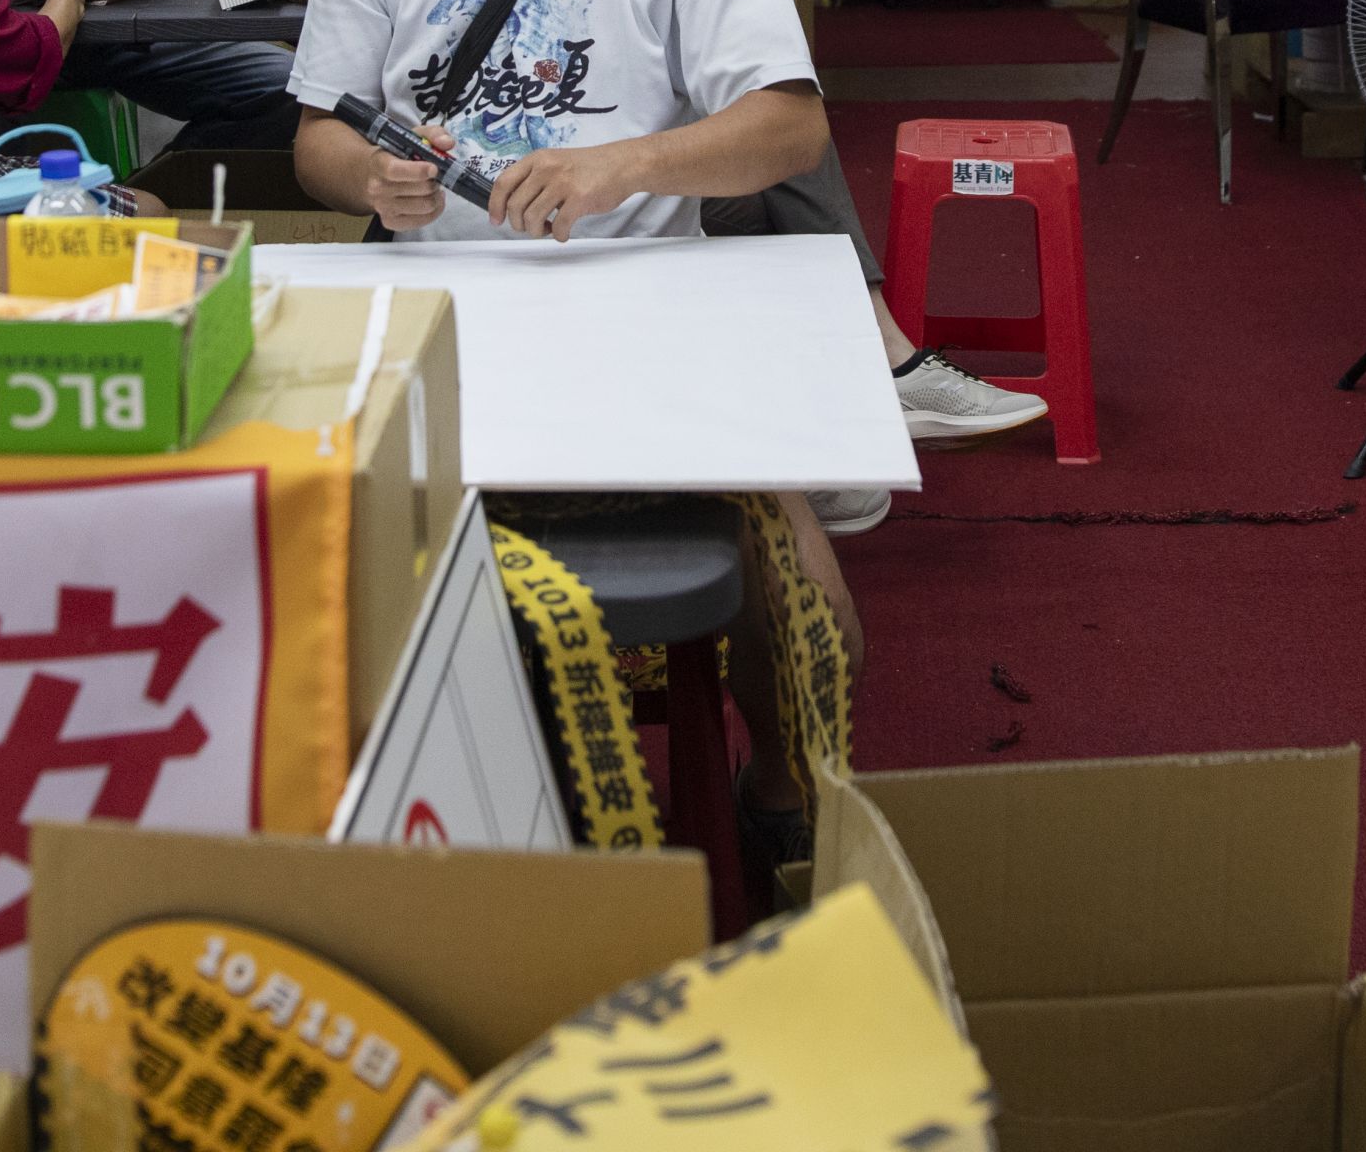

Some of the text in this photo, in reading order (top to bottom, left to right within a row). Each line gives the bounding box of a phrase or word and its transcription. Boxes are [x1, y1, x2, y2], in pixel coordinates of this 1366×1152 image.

[8, 373, 146, 431] BLC
[522, 574, 589, 650] 1013
[117, 956, 329, 1116] 改變基隆
[196, 935, 403, 1092] 10月13日
